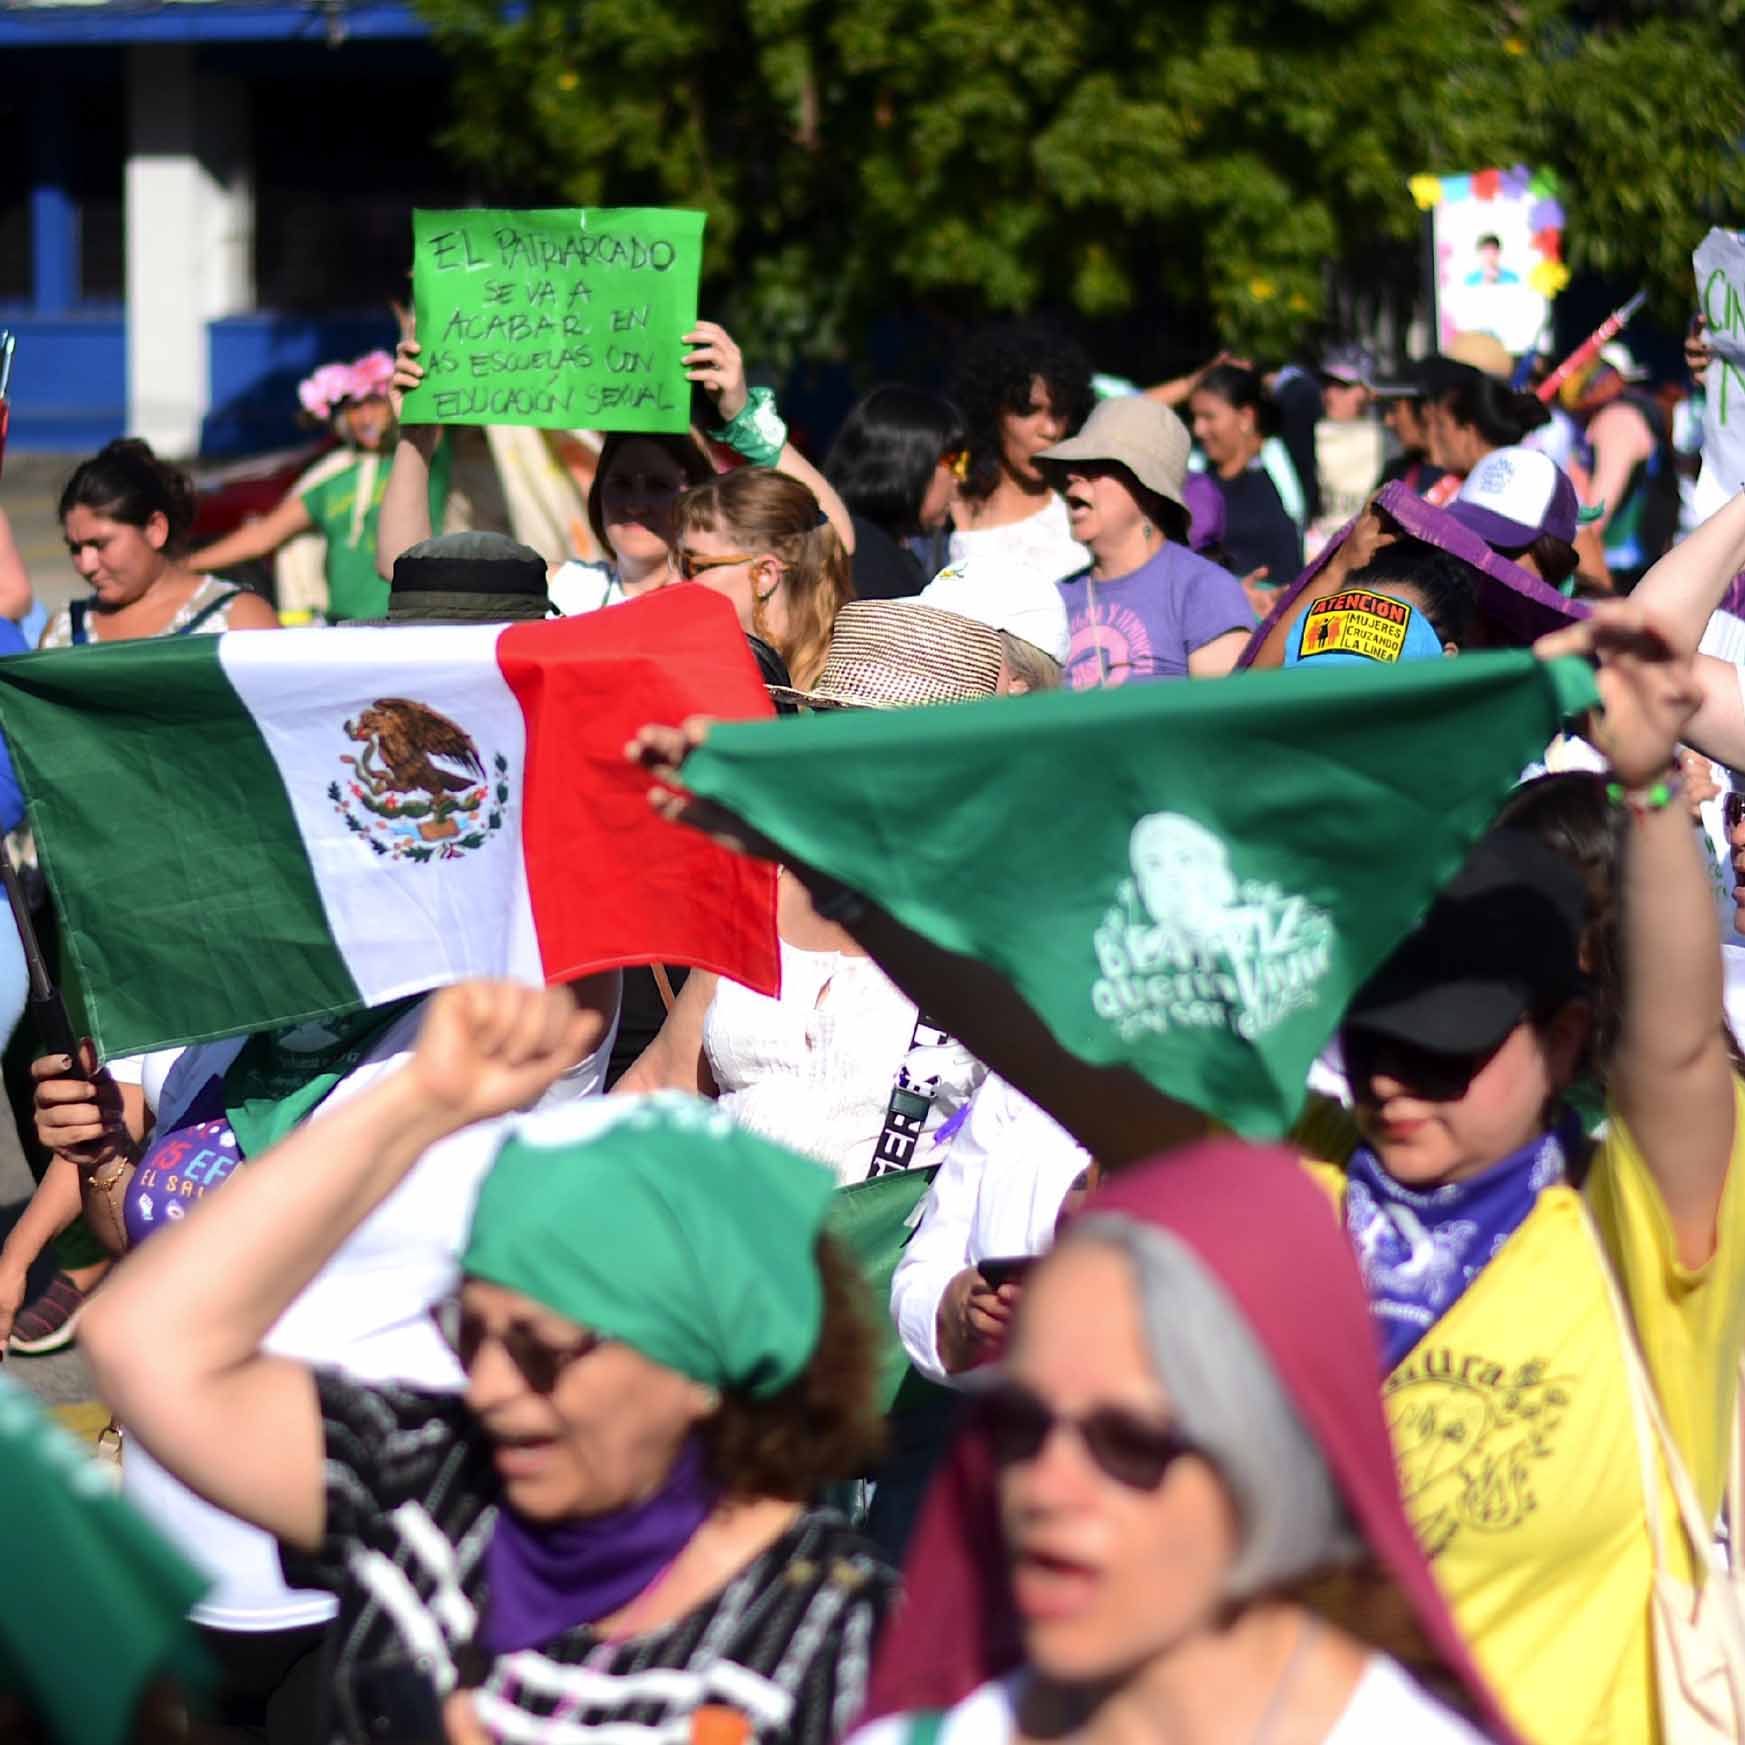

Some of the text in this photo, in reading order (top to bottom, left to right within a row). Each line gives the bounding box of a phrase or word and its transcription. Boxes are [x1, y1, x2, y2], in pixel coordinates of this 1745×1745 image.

[429, 227, 676, 272] EL PATRIARCADO
[484, 280, 592, 307] SE VA A
[443, 304, 650, 343] ACABAR EN
[469, 348, 592, 377] ESCUELAS
[584, 383, 676, 415] SEXUAL
[1346, 626, 1399, 651] CRUZANDO
[1349, 613, 1401, 638] MUJERES
[1345, 640, 1360, 650] LA
[140, 1168, 157, 1188] EL
